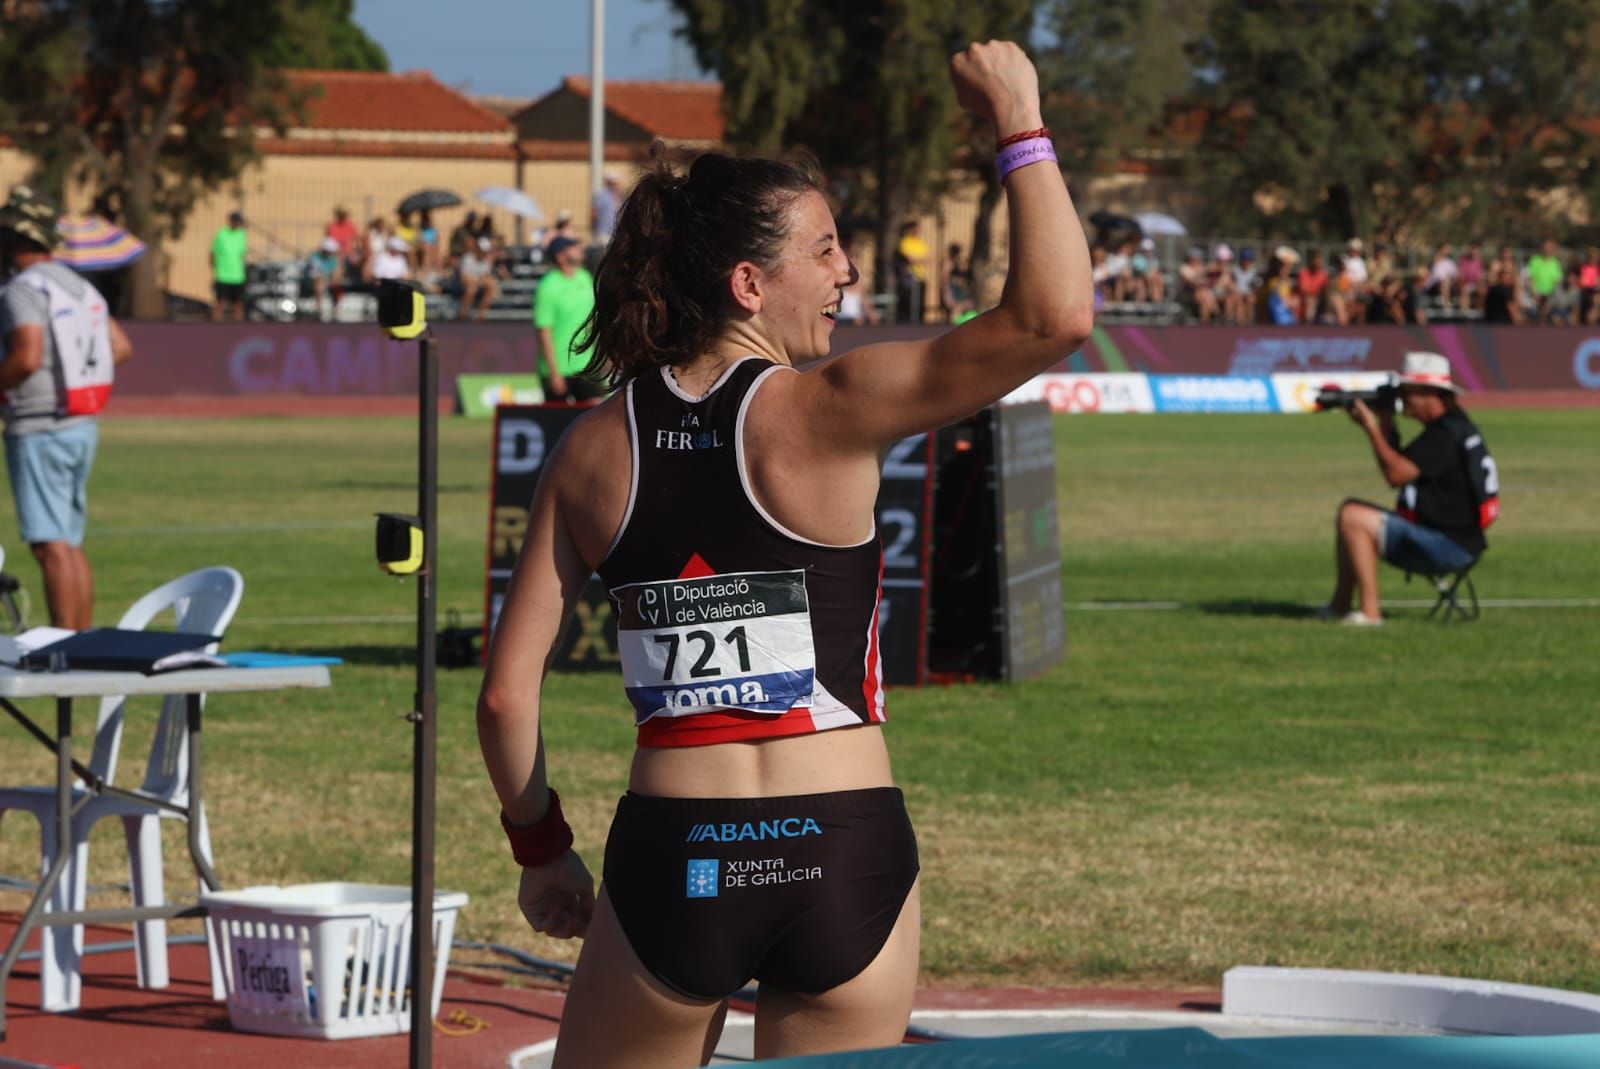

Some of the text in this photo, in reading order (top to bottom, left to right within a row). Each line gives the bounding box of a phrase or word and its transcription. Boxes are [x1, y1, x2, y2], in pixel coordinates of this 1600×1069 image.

[673, 579, 749, 604] Diputació
[675, 600, 766, 623] de València
[654, 626, 752, 681] 721
[725, 866, 823, 888] DE GALICIA
[726, 858, 785, 873] XUNTA
